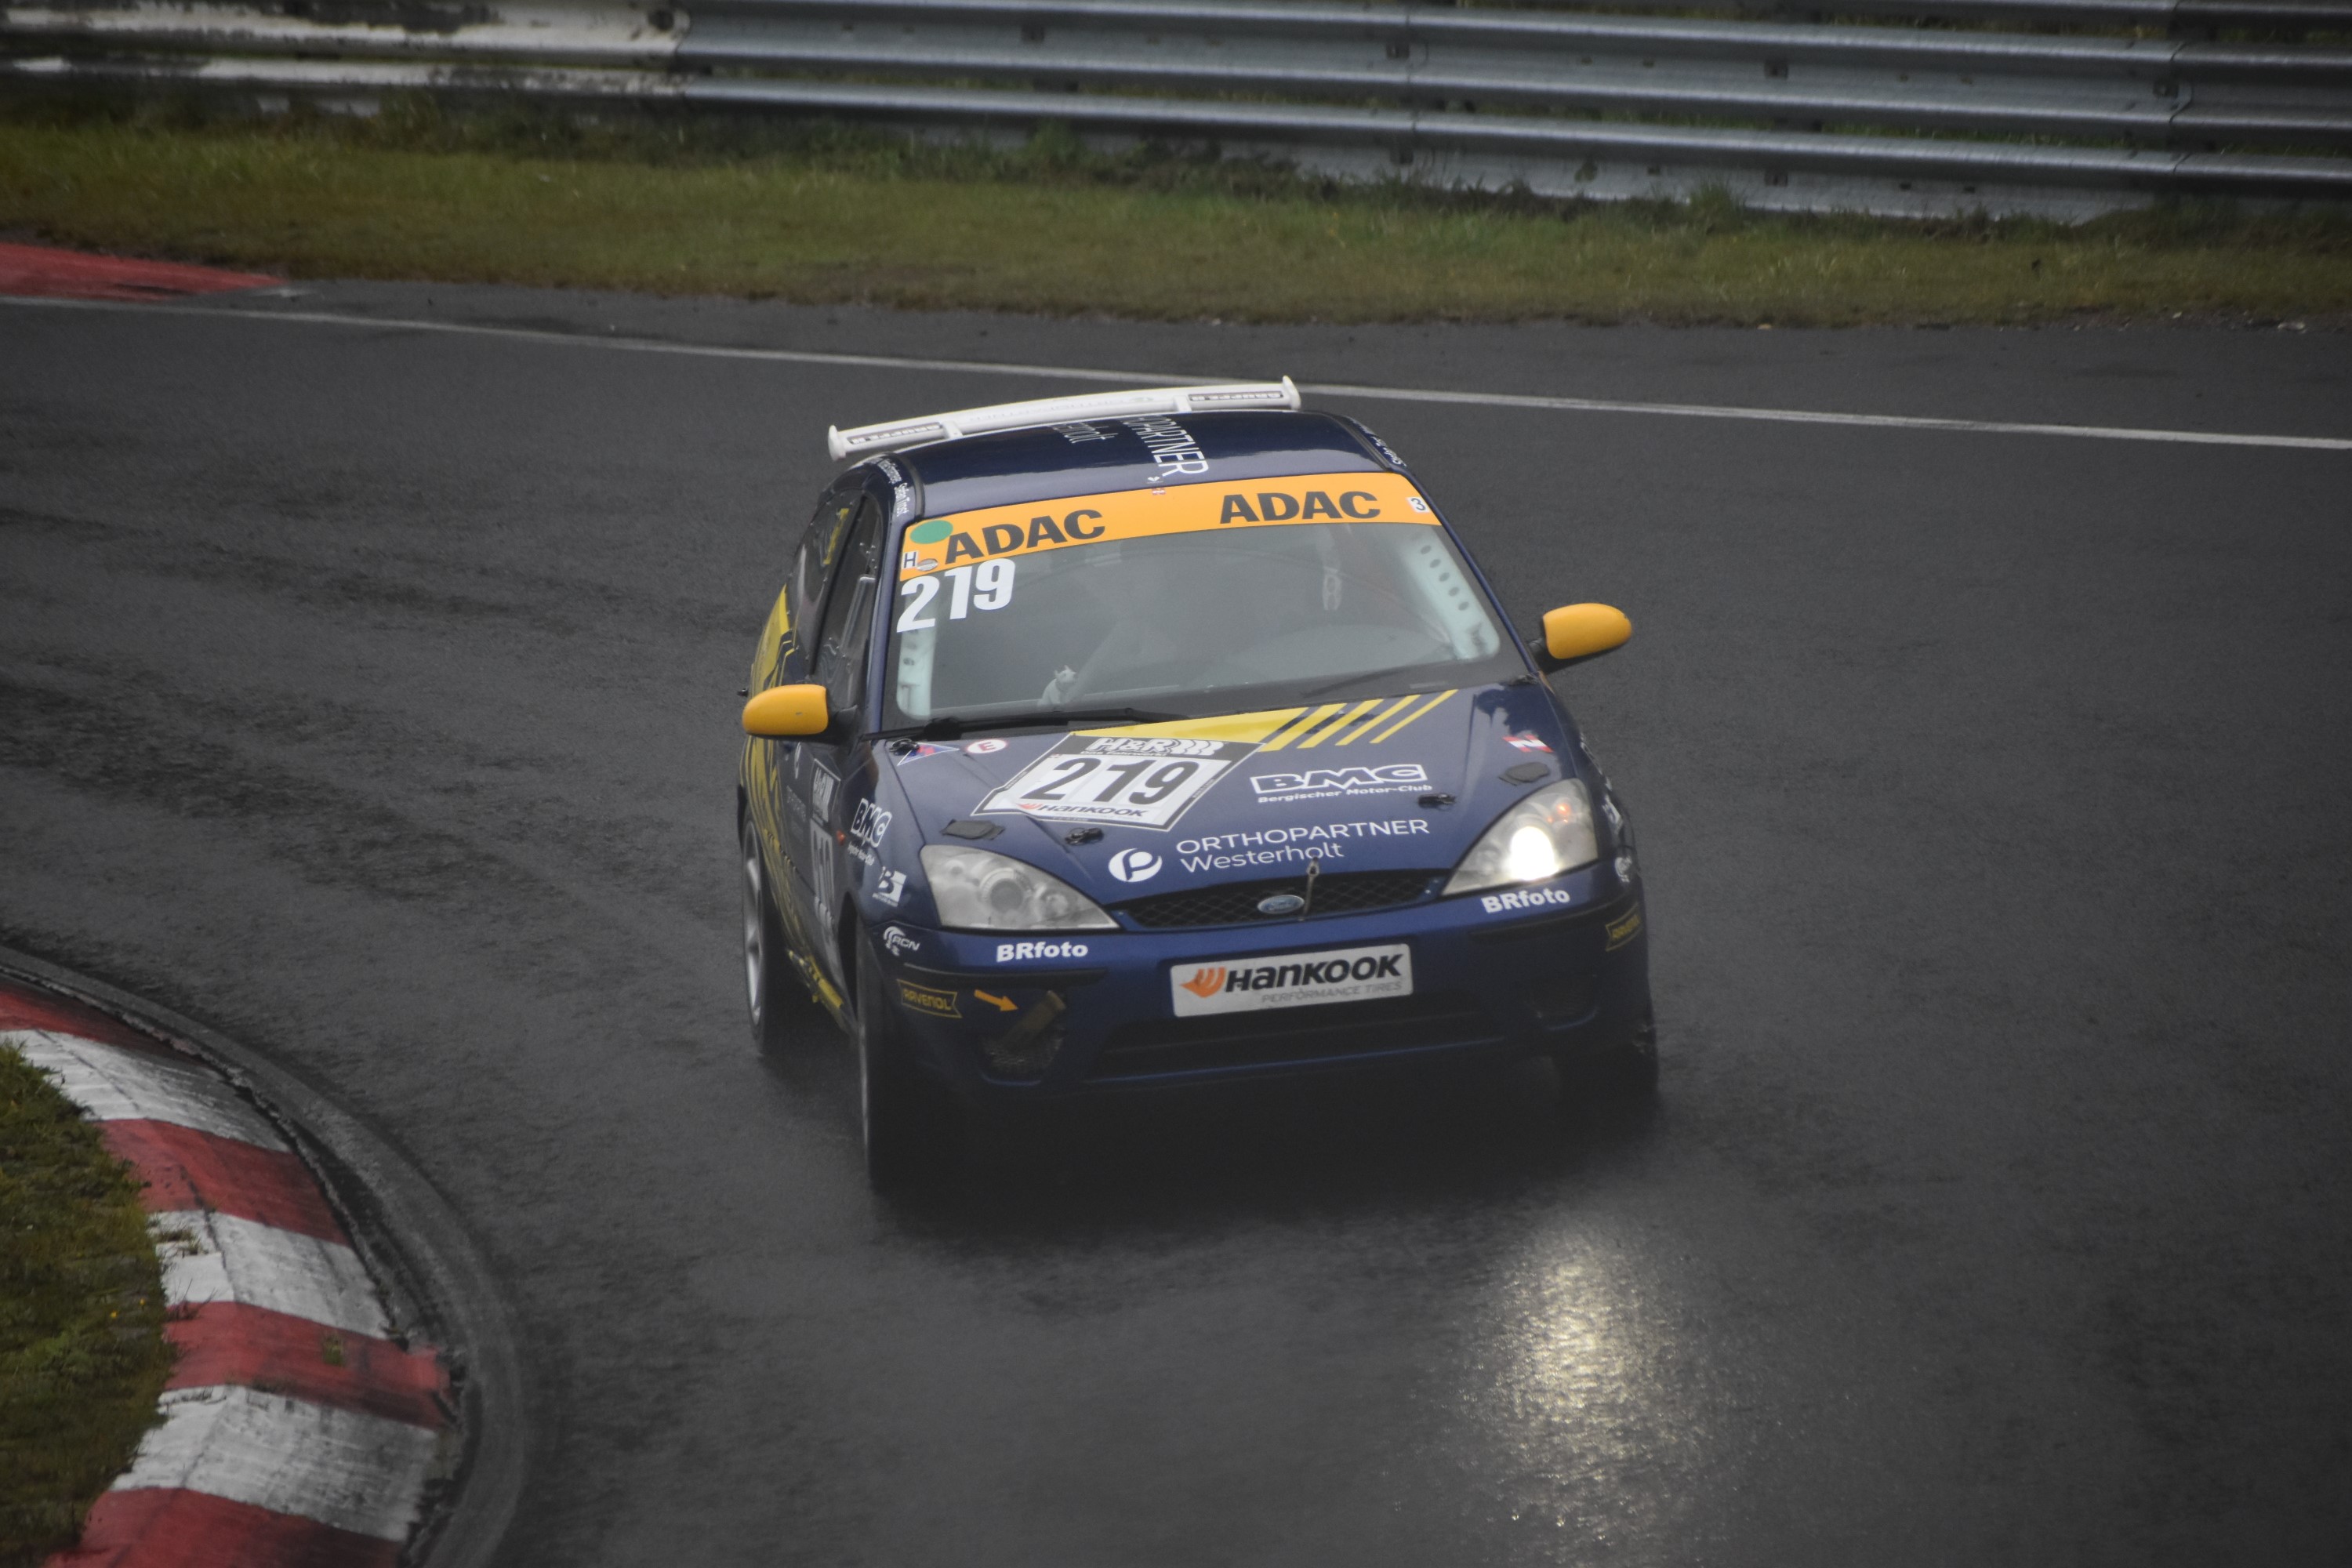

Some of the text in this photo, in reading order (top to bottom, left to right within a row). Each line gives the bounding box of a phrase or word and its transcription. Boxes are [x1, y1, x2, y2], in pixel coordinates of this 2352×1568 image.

[1219, 491, 1381, 524] ADAC
[1411, 497, 1427, 511] 3
[945, 510, 1105, 564] ADAC
[903, 551, 917, 569] H
[896, 558, 1016, 633] 219
[1019, 757, 1200, 805] 219
[1258, 784, 1433, 804] Bergischer Motor-Club
[1176, 819, 1430, 855] ORTHOPARTNER
[1181, 842, 1345, 873] Westerholt
[1481, 887, 1571, 914] BRfoto
[996, 942, 1088, 962] BRfoto
[1261, 974, 1403, 1004] PERFORMANCE TIRES
